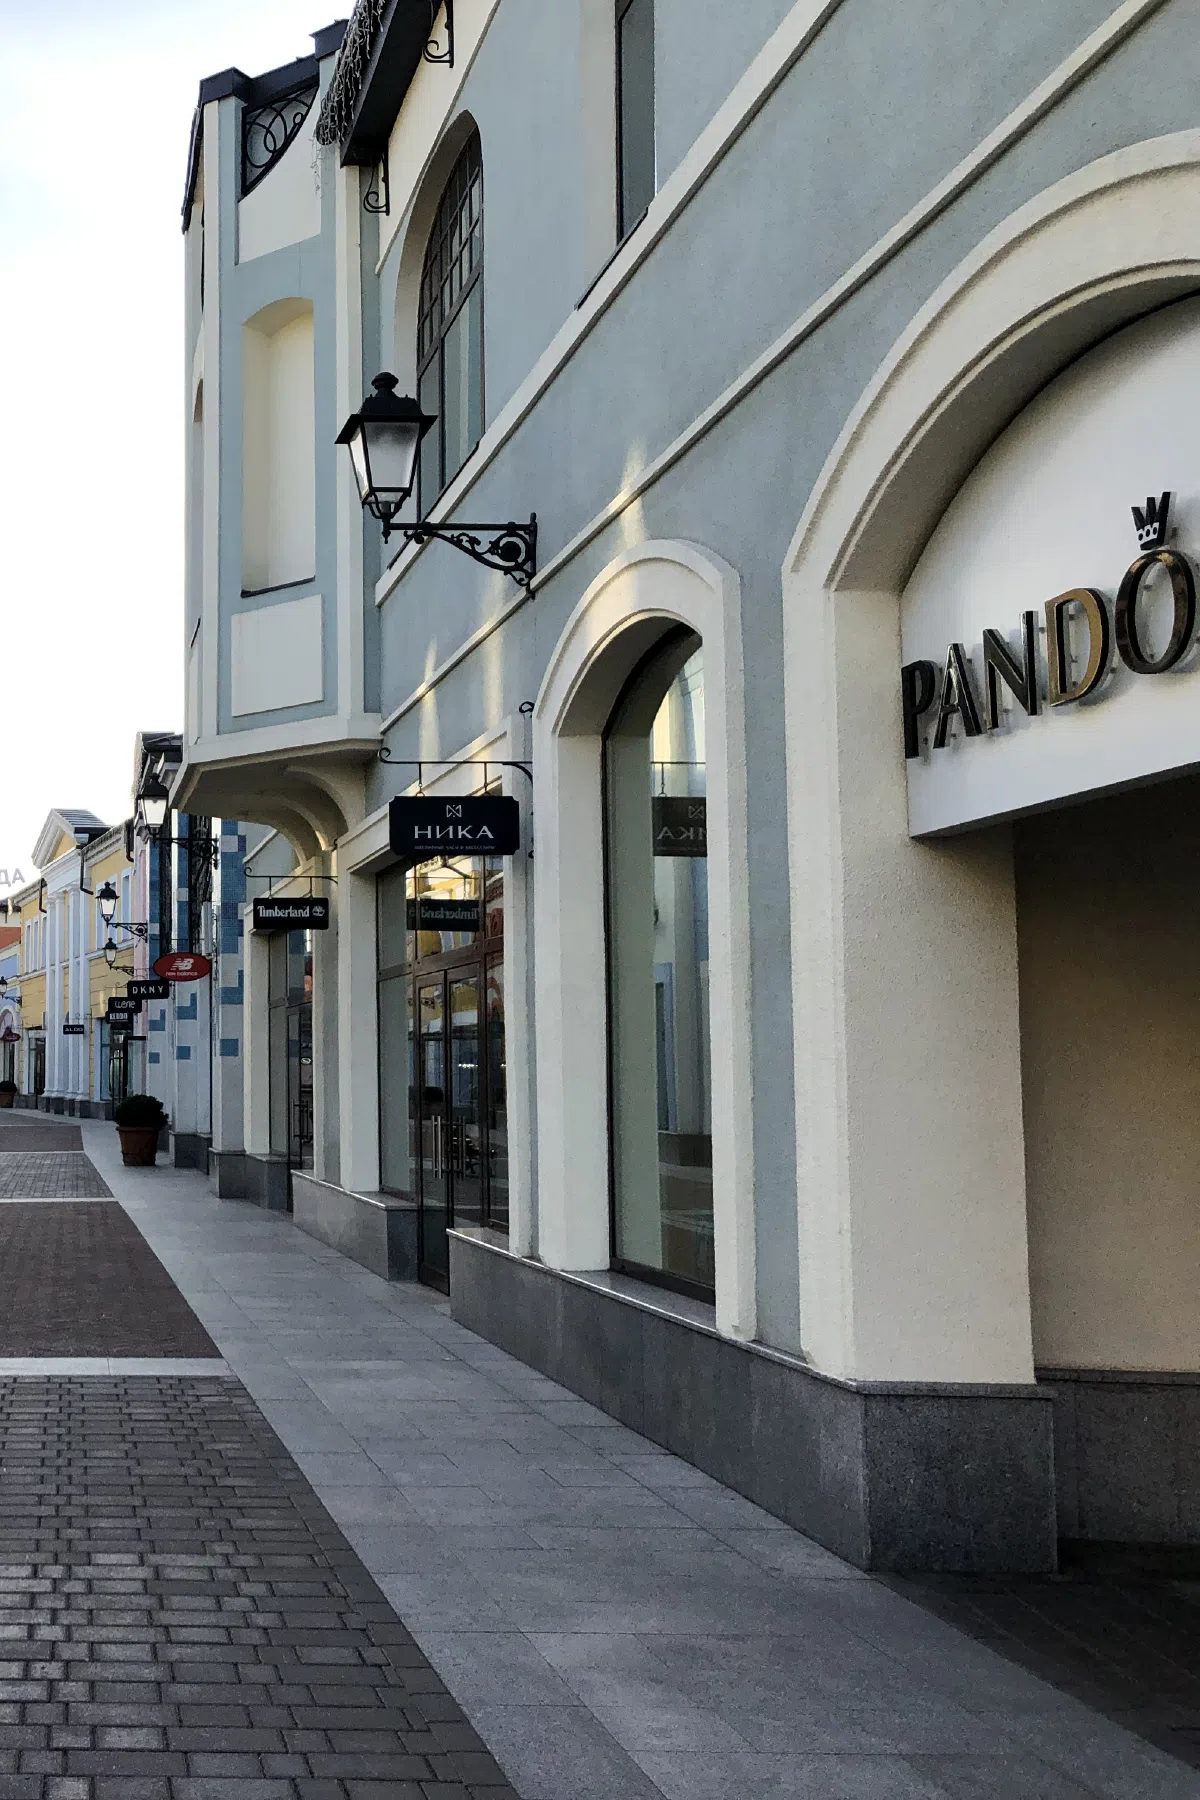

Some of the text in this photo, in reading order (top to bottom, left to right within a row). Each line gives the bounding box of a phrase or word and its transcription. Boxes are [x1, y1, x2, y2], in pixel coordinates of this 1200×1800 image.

[901, 549, 1198, 759] PANDO
[414, 825, 494, 839] НИКА
[257, 905, 310, 918] Timberland
[132, 986, 164, 994] DKNY
